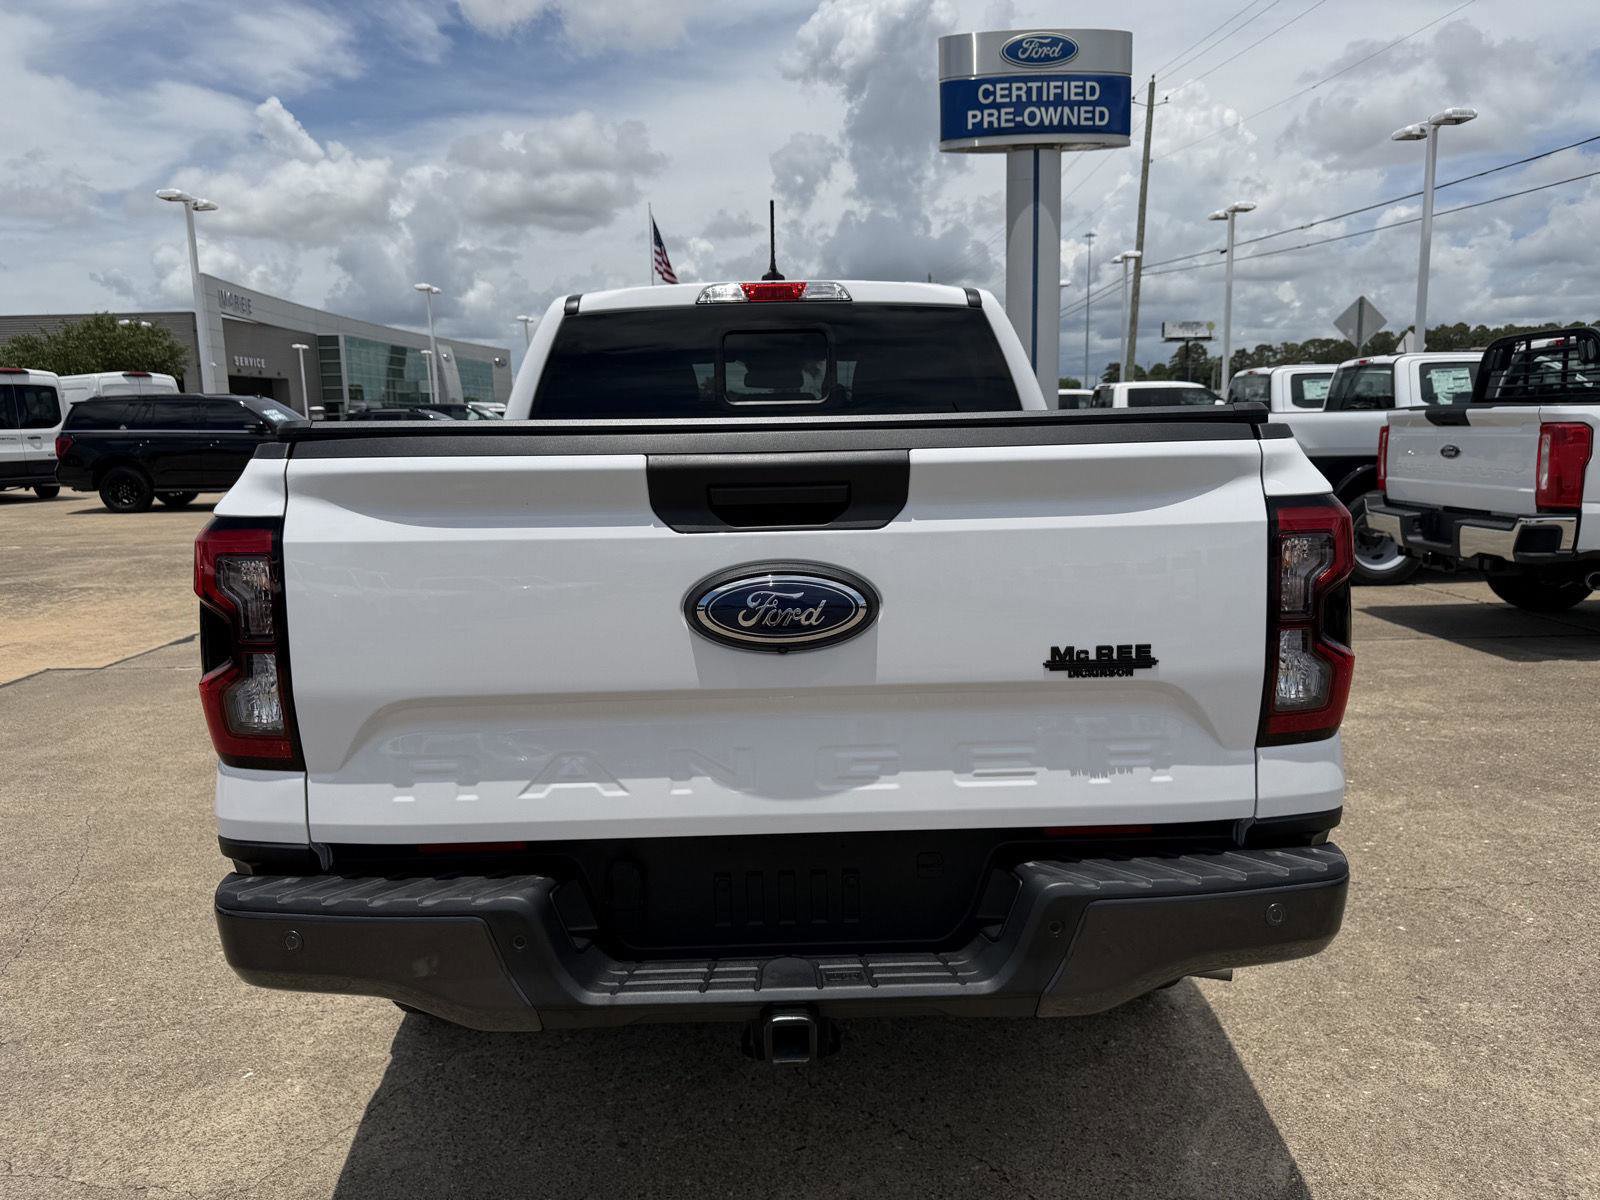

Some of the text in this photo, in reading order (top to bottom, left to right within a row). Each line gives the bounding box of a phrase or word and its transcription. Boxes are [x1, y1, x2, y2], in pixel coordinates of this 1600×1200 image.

[1018, 37, 1063, 59] Ford
[978, 81, 1099, 103] CERTIFIED
[967, 106, 1109, 128] PRE-OWNED
[233, 355, 266, 369] SERVICE
[737, 590, 827, 627] Ford
[393, 738, 1173, 801] RANGER
